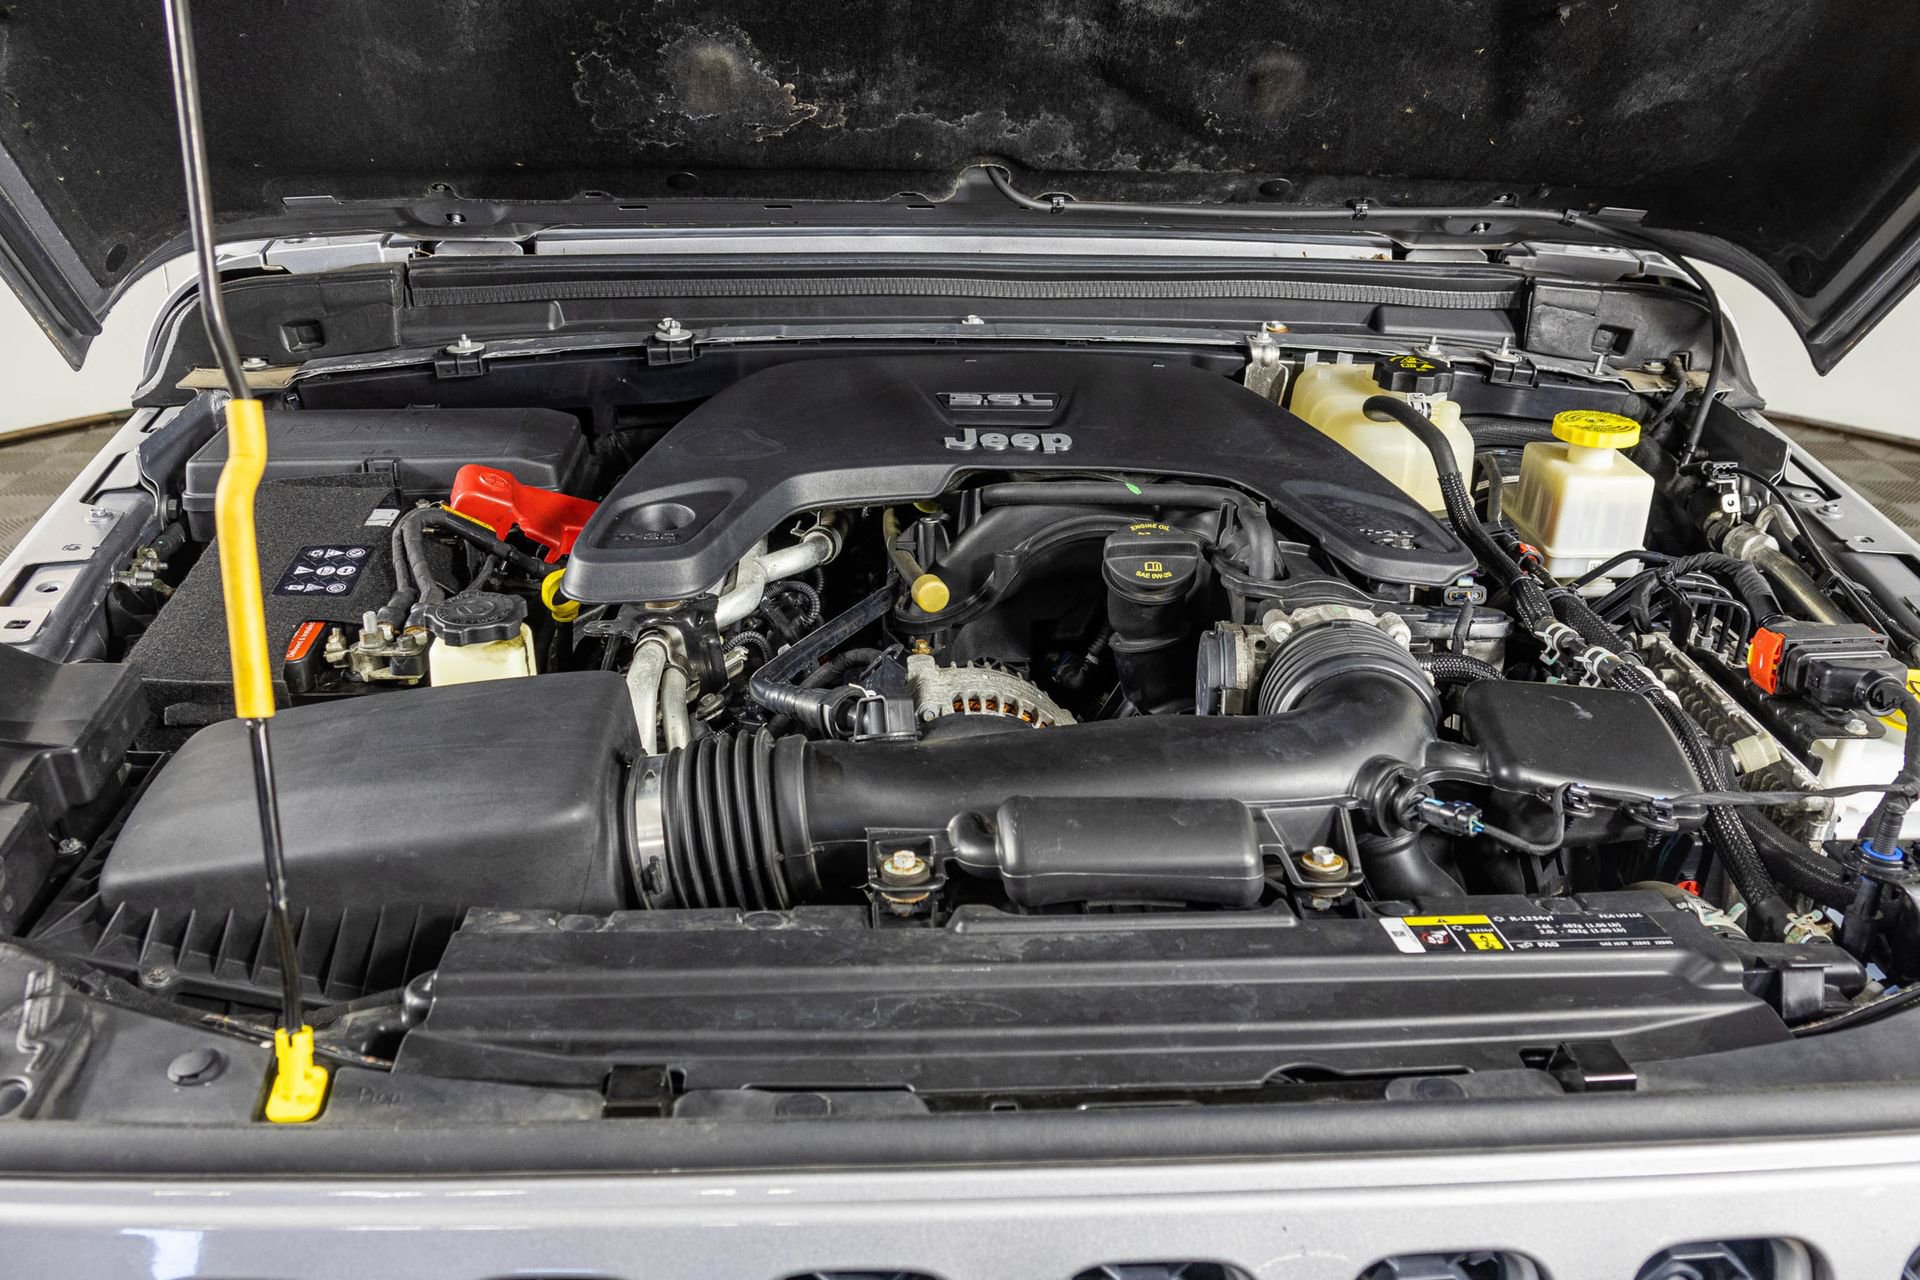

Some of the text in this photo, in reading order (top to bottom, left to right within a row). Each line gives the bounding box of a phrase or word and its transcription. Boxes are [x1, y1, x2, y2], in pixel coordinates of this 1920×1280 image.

[944, 427, 1073, 454] Jeep
[1130, 523, 1170, 531] ENGINE OIL
[1136, 570, 1150, 579] SAE
